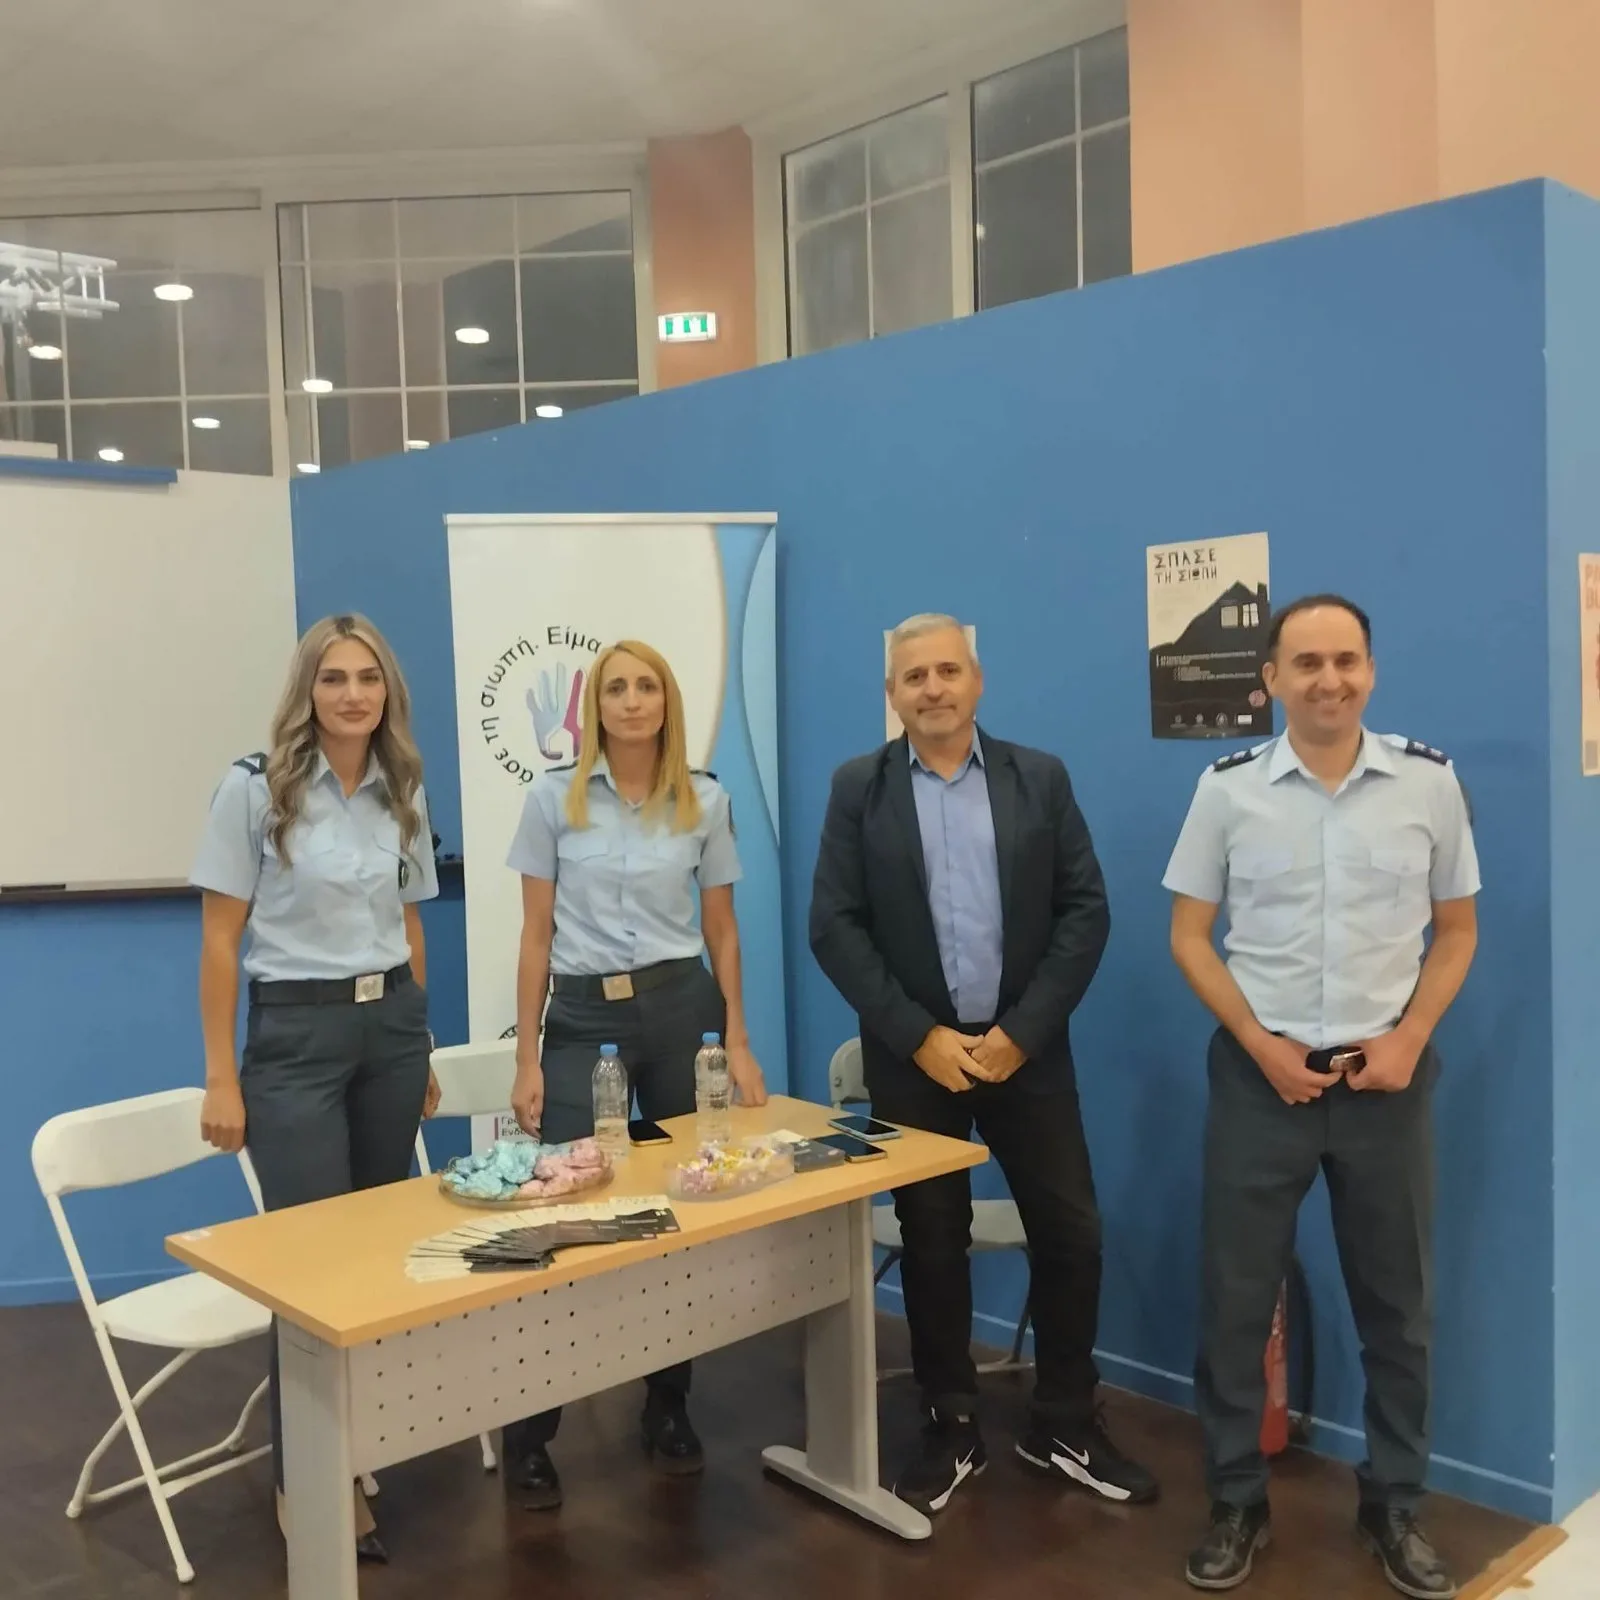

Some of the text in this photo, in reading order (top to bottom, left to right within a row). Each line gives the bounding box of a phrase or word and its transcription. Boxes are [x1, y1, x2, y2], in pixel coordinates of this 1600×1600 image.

[547, 625, 602, 654] Είμα
[480, 716, 499, 744] τη
[494, 747, 534, 786] άσε
